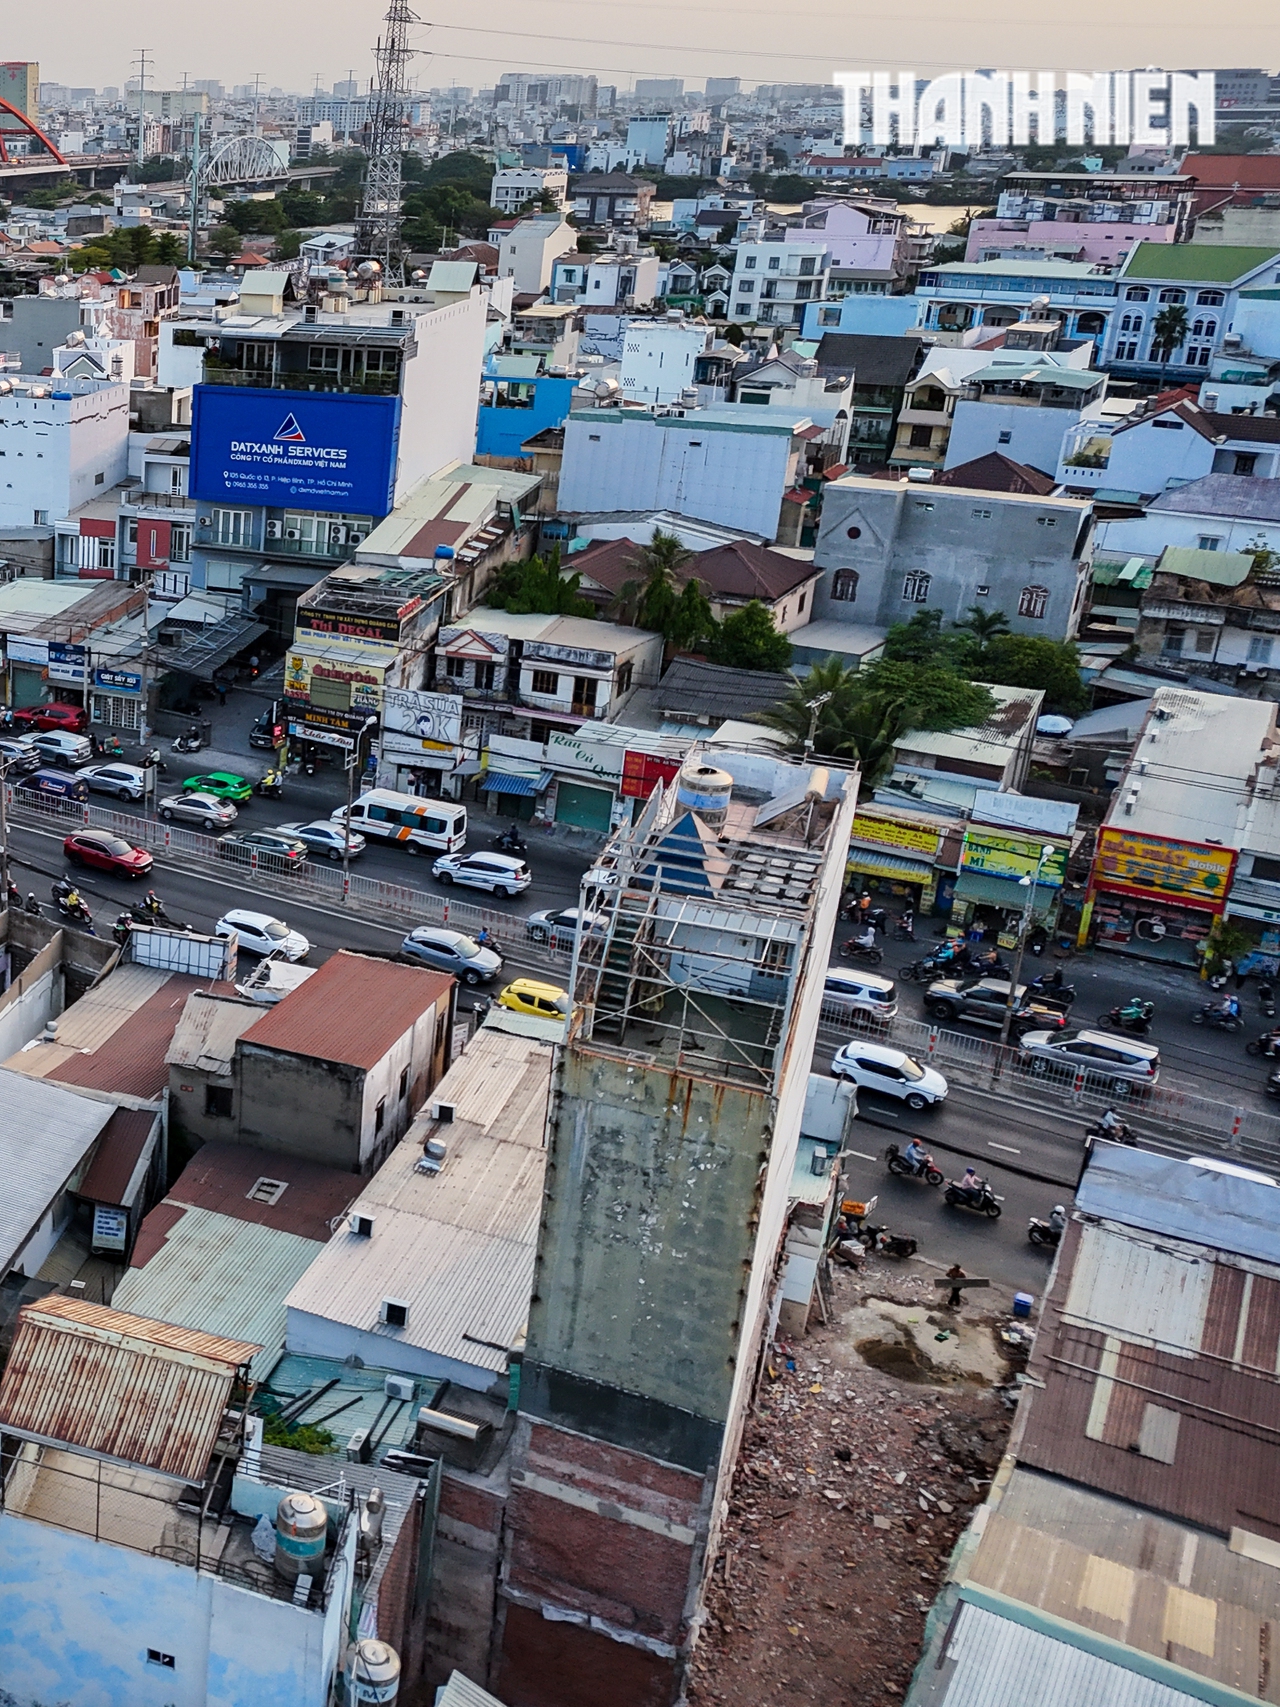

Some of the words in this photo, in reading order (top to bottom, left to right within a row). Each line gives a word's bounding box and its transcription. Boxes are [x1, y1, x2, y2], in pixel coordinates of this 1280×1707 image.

[231, 441, 283, 455] DATXANH
[288, 445, 347, 460] SERVICES
[329, 461, 347, 469] NAM
[310, 619, 333, 632] Thi
[338, 623, 384, 639] DECAL
[305, 713, 328, 724] MINH
[551, 733, 582, 750] Rau
[1188, 858, 1227, 874] Mobile
